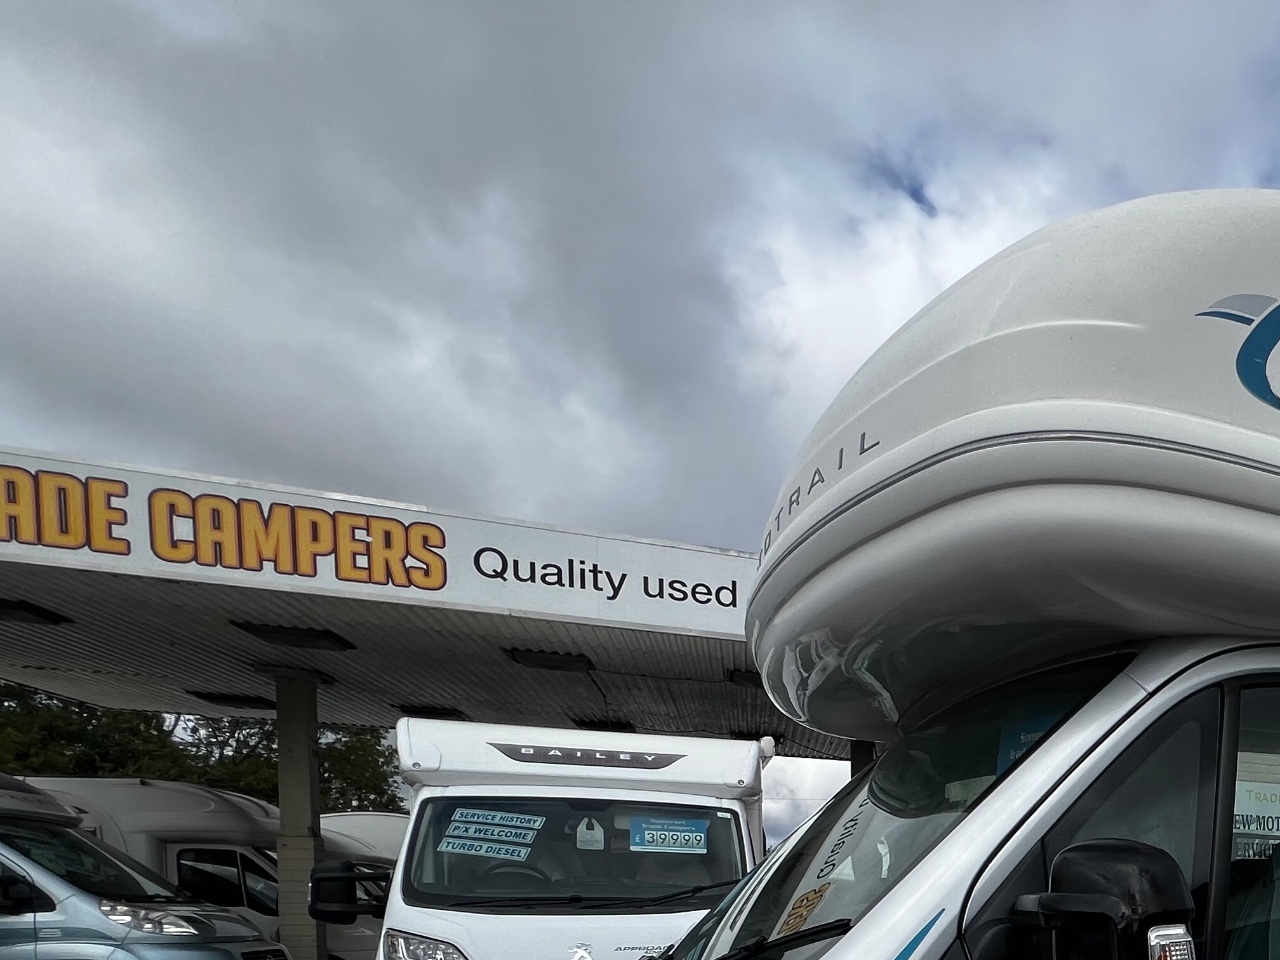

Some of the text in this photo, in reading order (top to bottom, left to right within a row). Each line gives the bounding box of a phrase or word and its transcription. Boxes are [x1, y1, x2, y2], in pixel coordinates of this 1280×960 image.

[148, 488, 447, 591] CAMPERS
[473, 546, 627, 601] Quality
[642, 575, 738, 608] used
[521, 747, 656, 761] BAILEY
[458, 811, 539, 825] SERVICE HISTORY
[452, 825, 530, 840] P/X WELCOME
[445, 841, 523, 857] TURBO DIESEL
